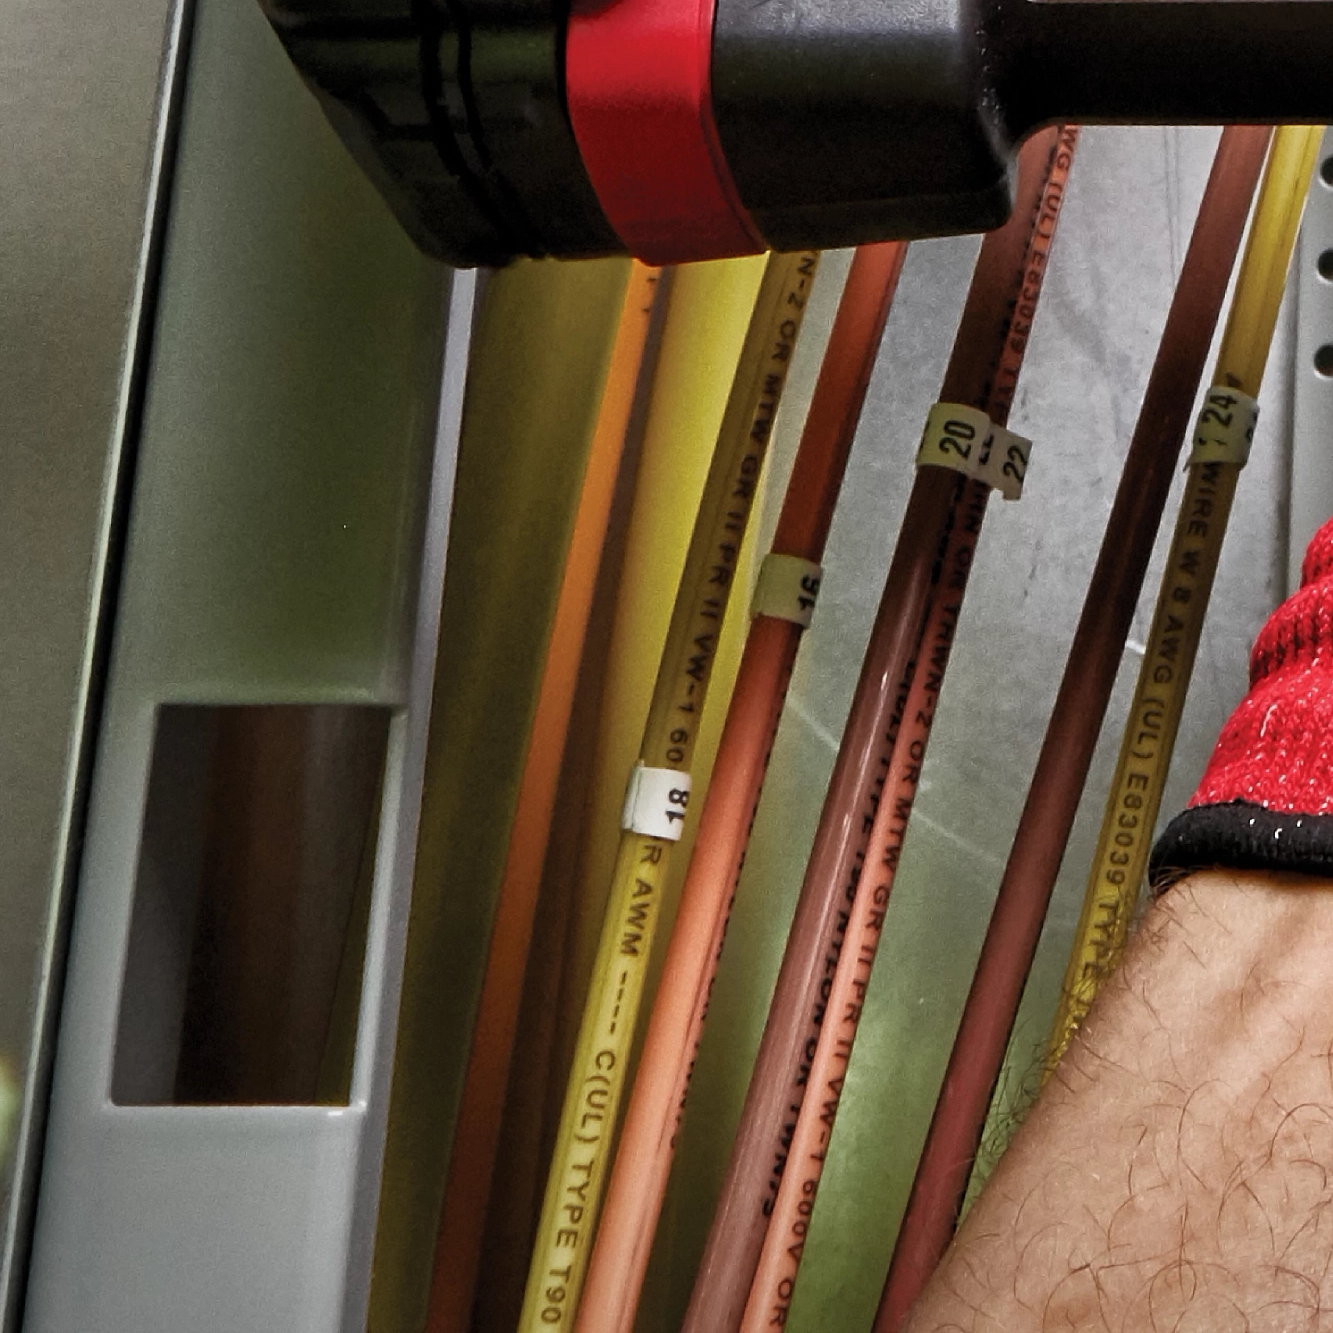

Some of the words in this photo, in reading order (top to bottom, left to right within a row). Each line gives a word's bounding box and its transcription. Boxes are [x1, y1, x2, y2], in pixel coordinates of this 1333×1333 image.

[1057, 126, 1079, 169] WG
[1037, 183, 1063, 240] (UL)
[770, 320, 798, 361] OR
[750, 373, 780, 447] MTW
[1201, 395, 1237, 429] 24
[939, 420, 975, 454] 20
[731, 455, 758, 499] GR
[1003, 445, 1027, 482] 22
[1188, 462, 1222, 537] WIRE
[707, 544, 735, 586] PR
[951, 546, 971, 589] OR
[1172, 587, 1193, 602] 8
[677, 633, 714, 714] VW-1
[916, 603, 958, 726] THWN-2
[1153, 615, 1185, 685] AWG
[666, 729, 688, 764] 60
[1131, 698, 1166, 759] (UL)
[902, 740, 924, 782] OR
[667, 788, 691, 824] 18
[1105, 773, 1148, 884] E83039
[882, 799, 910, 866] MTW
[619, 878, 653, 956] AWM
[867, 885, 889, 929] GR
[844, 978, 867, 1024] PR
[576, 1050, 616, 1144] C(UL)
[810, 1077, 843, 1161] VW-1
[557, 1159, 594, 1248] TYPE
[787, 1180, 816, 1261] 600V
[542, 1265, 572, 1323] T90
[769, 1278, 792, 1325] OR
